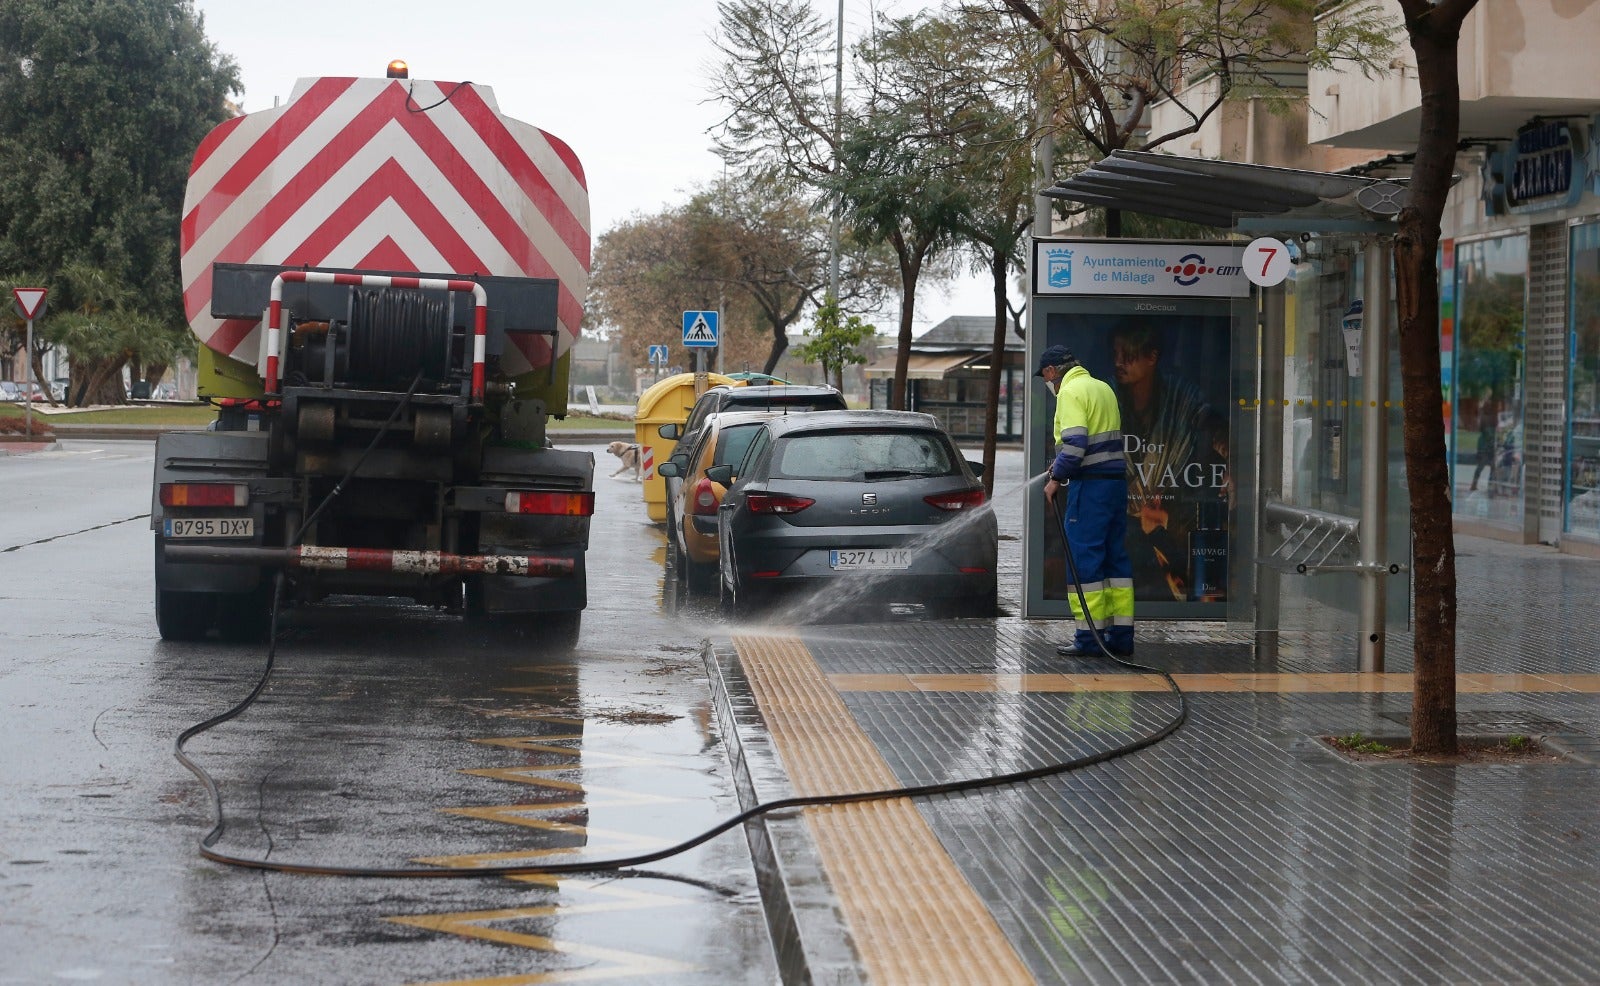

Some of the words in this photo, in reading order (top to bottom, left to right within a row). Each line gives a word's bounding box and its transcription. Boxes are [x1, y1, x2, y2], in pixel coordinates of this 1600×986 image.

[1083, 255, 1166, 269] Ayuntamiento
[1258, 247, 1278, 277] 7
[1093, 271, 1108, 282] de
[1112, 271, 1155, 284] Málaga
[1216, 265, 1243, 276] EMT
[1134, 303, 1177, 312] JCDecaux
[1122, 434, 1165, 454] Dior
[1134, 462, 1230, 488] VAGE
[174, 520, 214, 535] 0795
[220, 520, 249, 535] DXY
[839, 551, 876, 565] 5274
[881, 551, 908, 565] JYK
[1191, 548, 1228, 557] SAUVAGE
